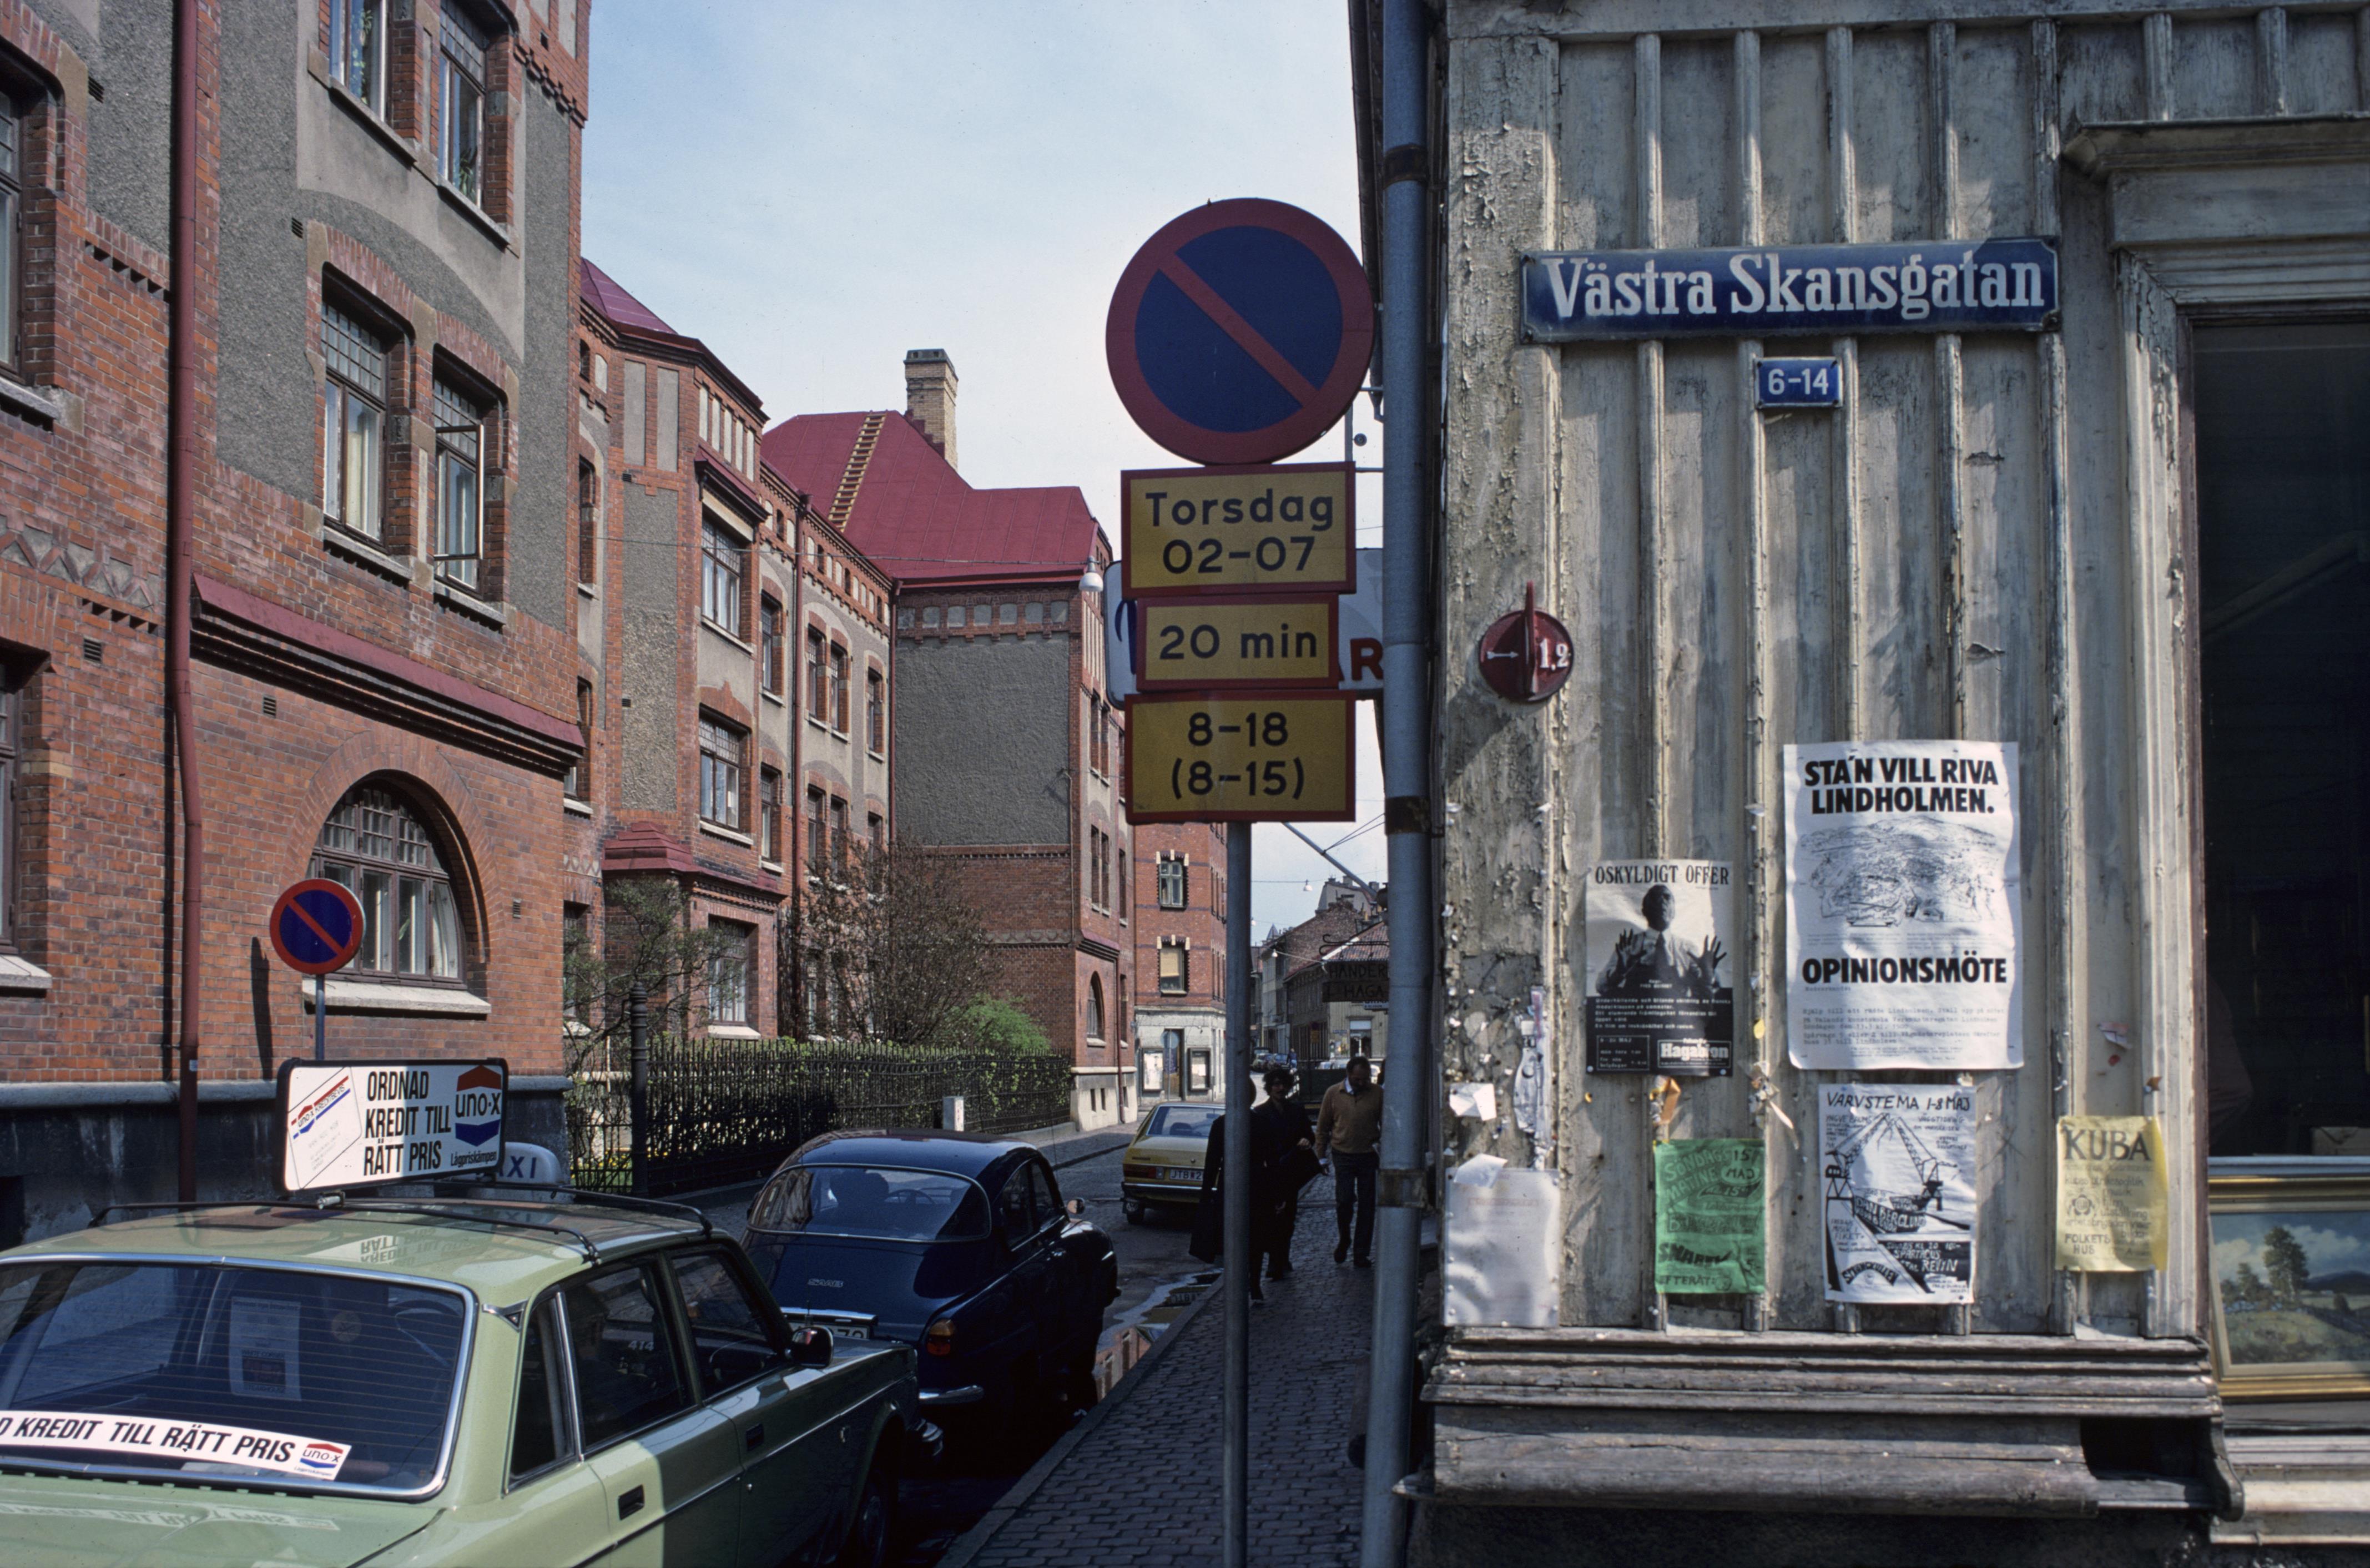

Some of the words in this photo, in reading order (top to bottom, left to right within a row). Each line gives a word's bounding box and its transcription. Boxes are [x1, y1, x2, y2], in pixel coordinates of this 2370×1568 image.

[1541, 258, 1716, 317] Västra
[1730, 253, 2044, 320] Skansgatan
[1767, 367, 1829, 396] 6-14
[1145, 488, 1333, 531] Torsdag
[1163, 536, 1315, 574] 02-07
[1159, 624, 1220, 660] 20
[1241, 623, 1317, 659] min
[1188, 712, 1288, 748] 8-18
[1172, 757, 1304, 799] (8-15)
[1879, 758, 1935, 783] VILL
[1941, 758, 1999, 785] RIVA
[1812, 787, 1995, 814] LINDHOLMEN.
[1595, 865, 1678, 884] OSKYLDIGT
[1685, 865, 1729, 885] OFFER
[1802, 950, 2006, 984] OPINIONSMÖTE
[1660, 1043, 1728, 1061] Hagabion
[367, 1071, 429, 1101] ORDNAD
[1948, 1096, 1970, 1111] MAJ
[365, 1107, 420, 1139] KREDIT
[426, 1106, 452, 1135] TILL
[364, 1137, 405, 1176] RÄTT
[409, 1141, 442, 1171] PRIS
[451, 1148, 497, 1167] Lågpriskämpen
[2063, 1128, 2151, 1161] KUBA
[507, 1156, 537, 1178] XI
[2065, 1233, 2110, 1244] FOLKETS
[2074, 1244, 2095, 1254] HUS
[808, 1278, 844, 1288] SAAB
[628, 1340, 654, 1351] 414
[14, 1418, 103, 1440] KREDIT
[109, 1422, 156, 1445] TILL
[160, 1424, 232, 1449] RÄTT
[232, 1435, 296, 1463] PRIS
